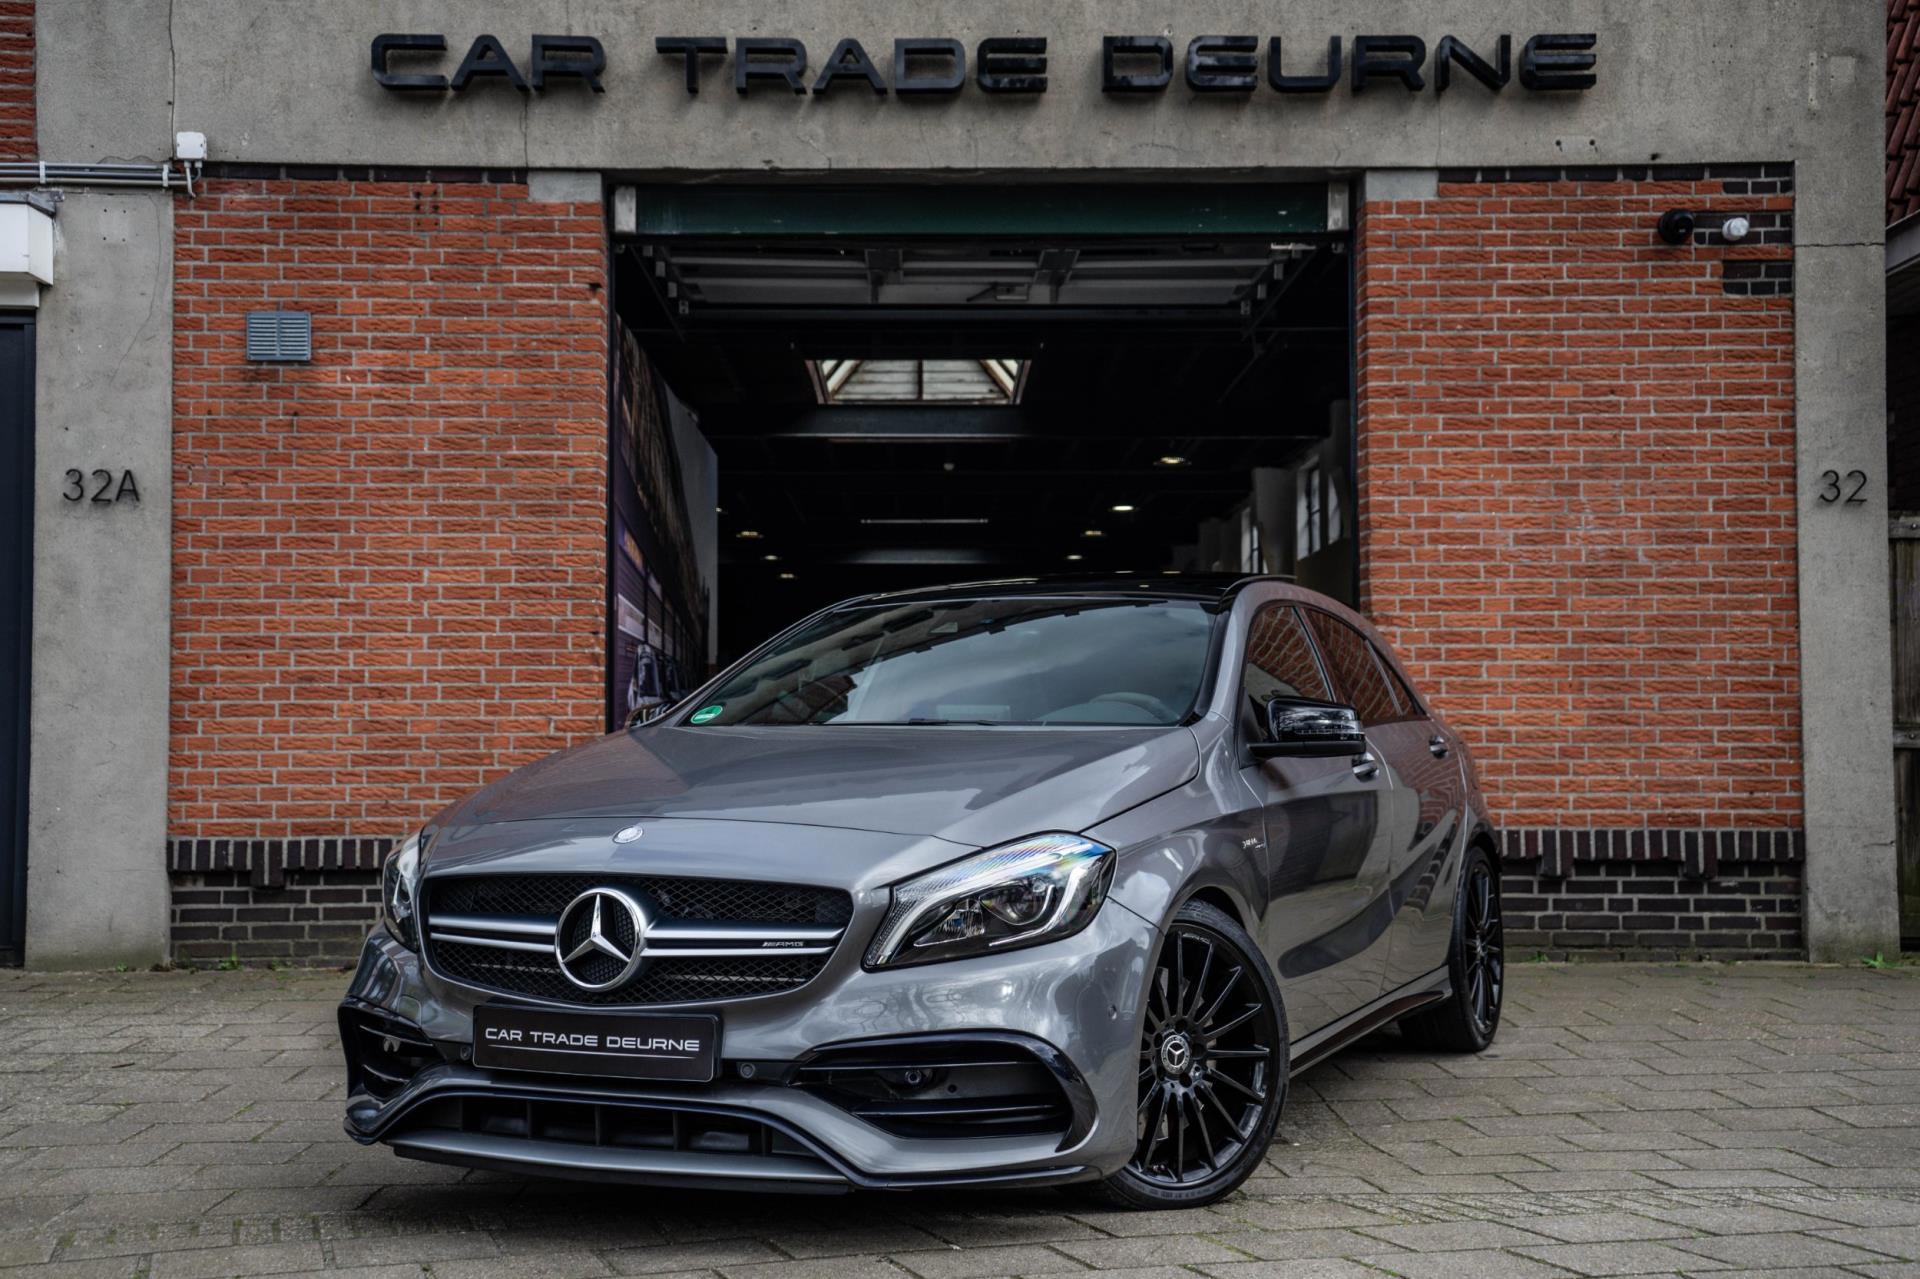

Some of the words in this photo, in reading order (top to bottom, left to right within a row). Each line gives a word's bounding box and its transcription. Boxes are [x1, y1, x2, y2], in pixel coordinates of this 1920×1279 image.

[371, 34, 606, 93] CAR
[655, 37, 1047, 95] TRADE
[1102, 33, 1597, 93] DEURNE
[62, 468, 140, 502] 32A
[1819, 469, 1868, 503] 32
[485, 1027, 522, 1042] CAR
[530, 1031, 599, 1047] TRADE
[606, 1036, 700, 1052] DEURNE
